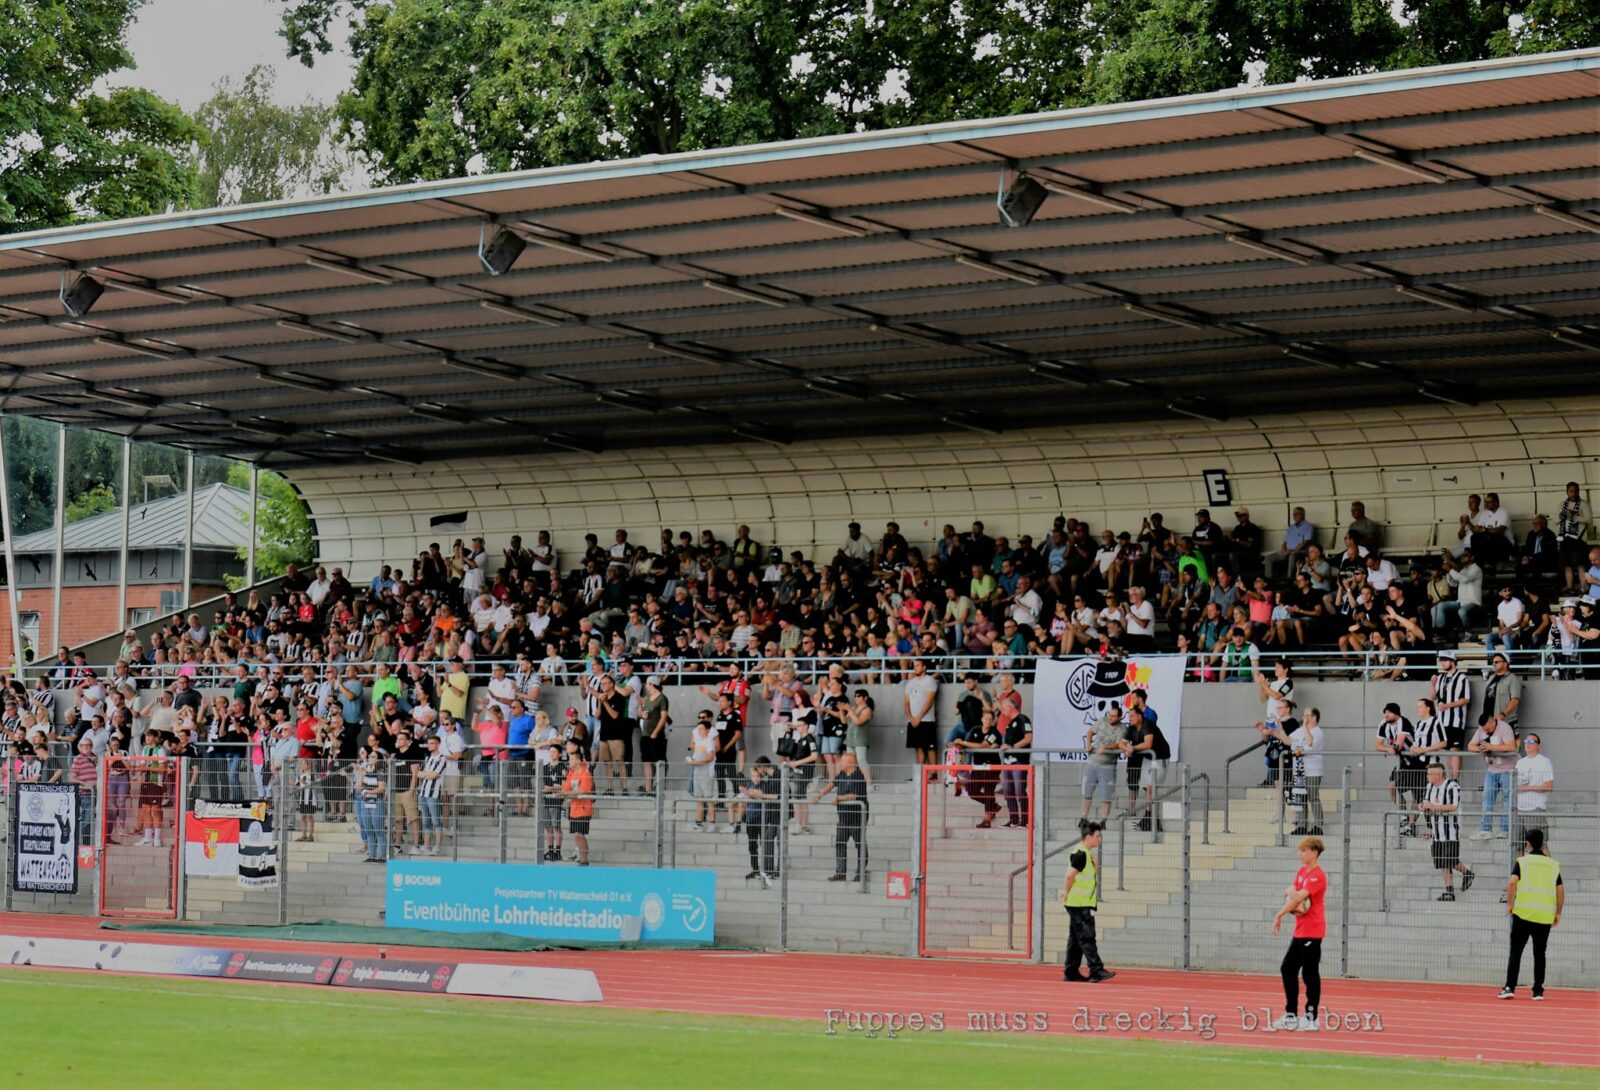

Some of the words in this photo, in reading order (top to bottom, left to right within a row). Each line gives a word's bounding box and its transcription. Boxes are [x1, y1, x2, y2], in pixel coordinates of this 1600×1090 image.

[1205, 473, 1229, 502] E
[405, 874, 442, 886] BOCHUM
[494, 887, 545, 900] Projektpartner
[548, 889, 558, 899] TV
[559, 890, 607, 901] Wattenscheid
[403, 899, 490, 924] Eventbühne
